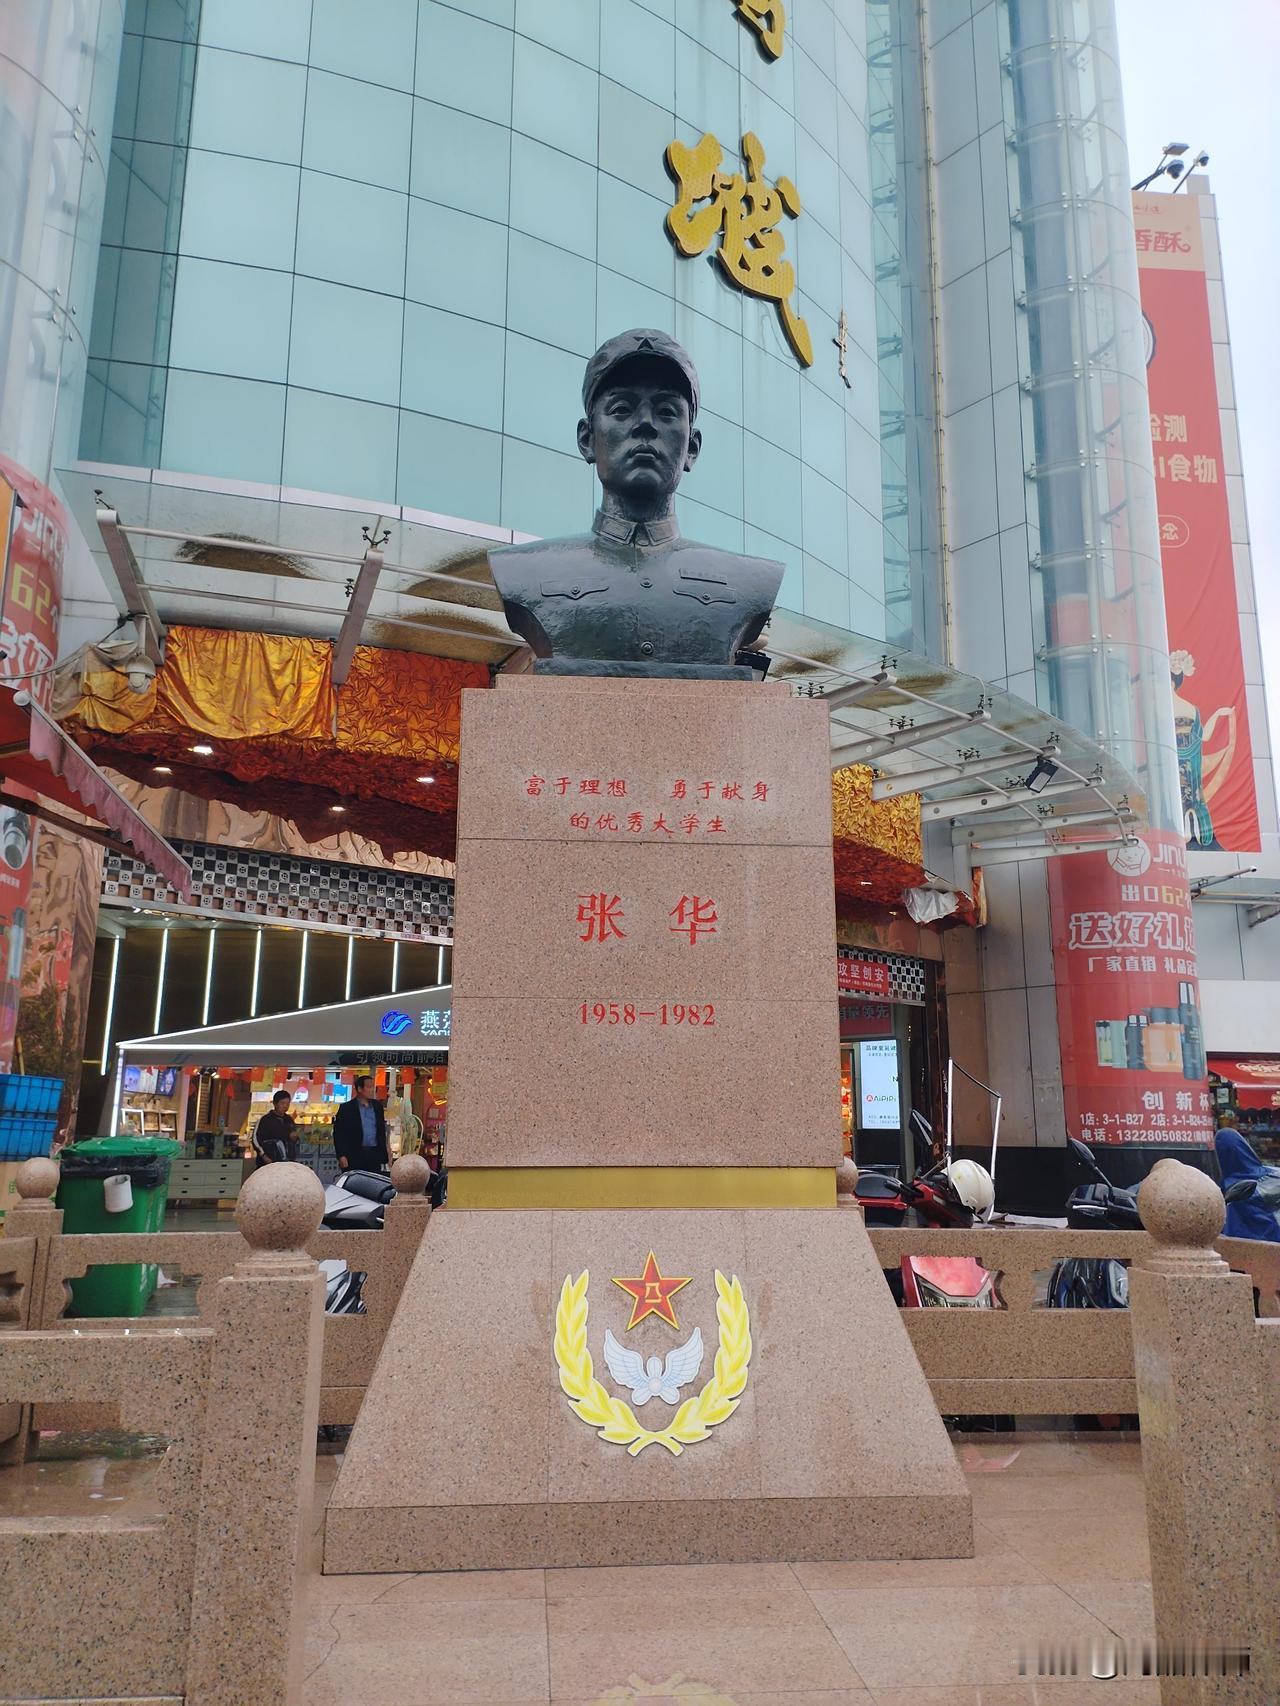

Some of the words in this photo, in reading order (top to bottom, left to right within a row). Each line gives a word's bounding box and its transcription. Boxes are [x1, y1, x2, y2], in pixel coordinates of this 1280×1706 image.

[525, 774, 628, 798] 富于理想
[669, 779, 770, 802] 勇于献身
[569, 811, 728, 834] 的优秀大学生
[1087, 956, 1158, 973] 厂家直销
[578, 1002, 717, 1027] 1958-1982
